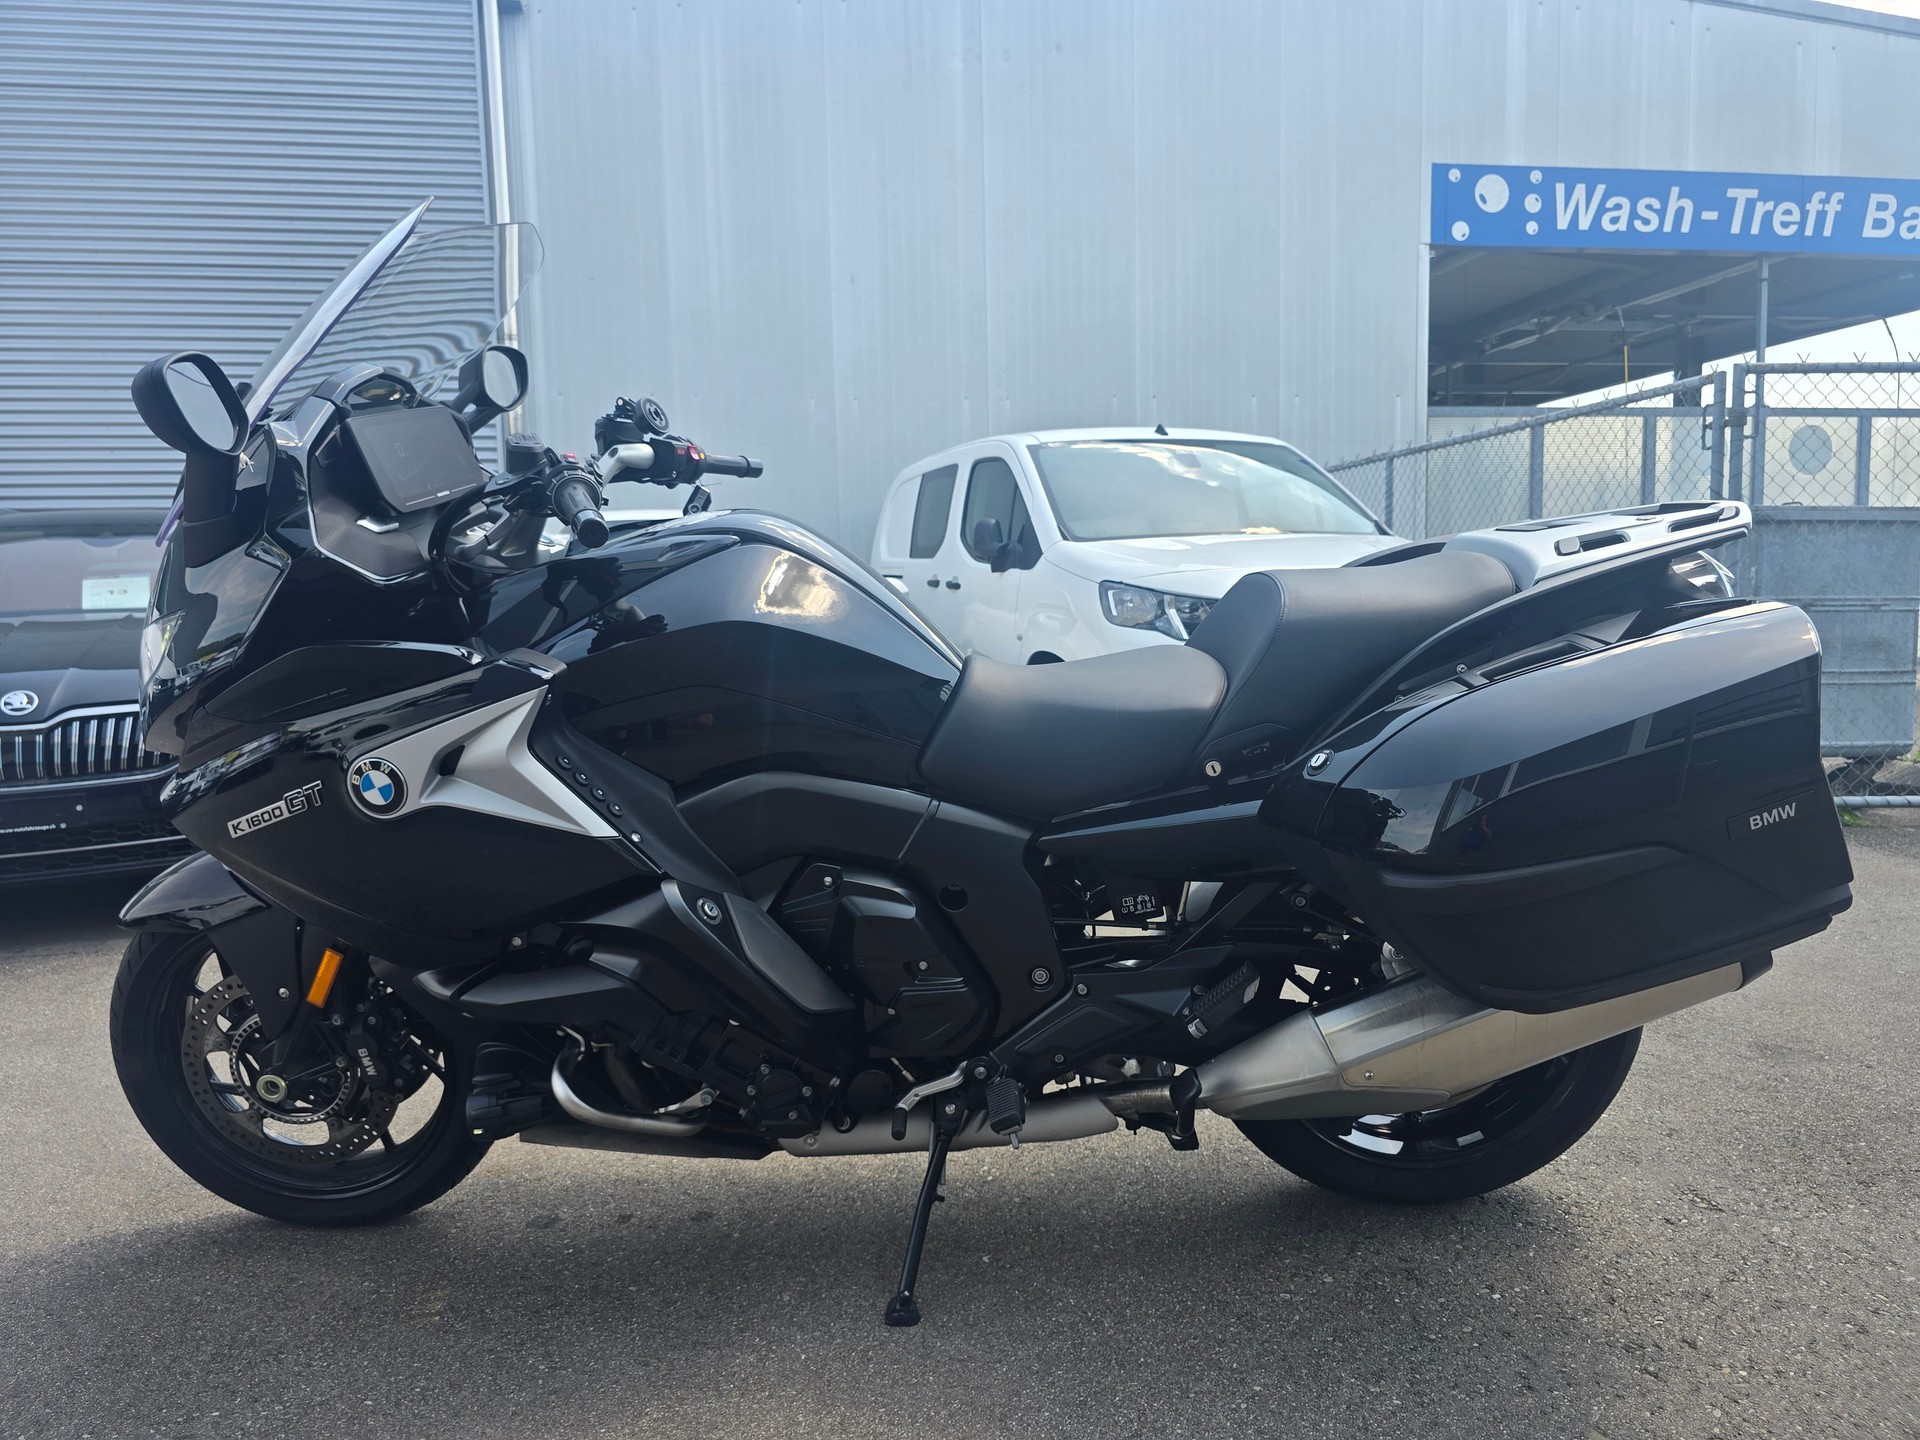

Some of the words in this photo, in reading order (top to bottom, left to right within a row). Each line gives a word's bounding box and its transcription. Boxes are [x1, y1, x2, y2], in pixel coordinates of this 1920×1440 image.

[1554, 182, 1844, 238] Wash-Treff
[352, 761, 392, 786] BMW
[1749, 802, 1796, 830] BMW
[357, 1048, 377, 1076] BMW
